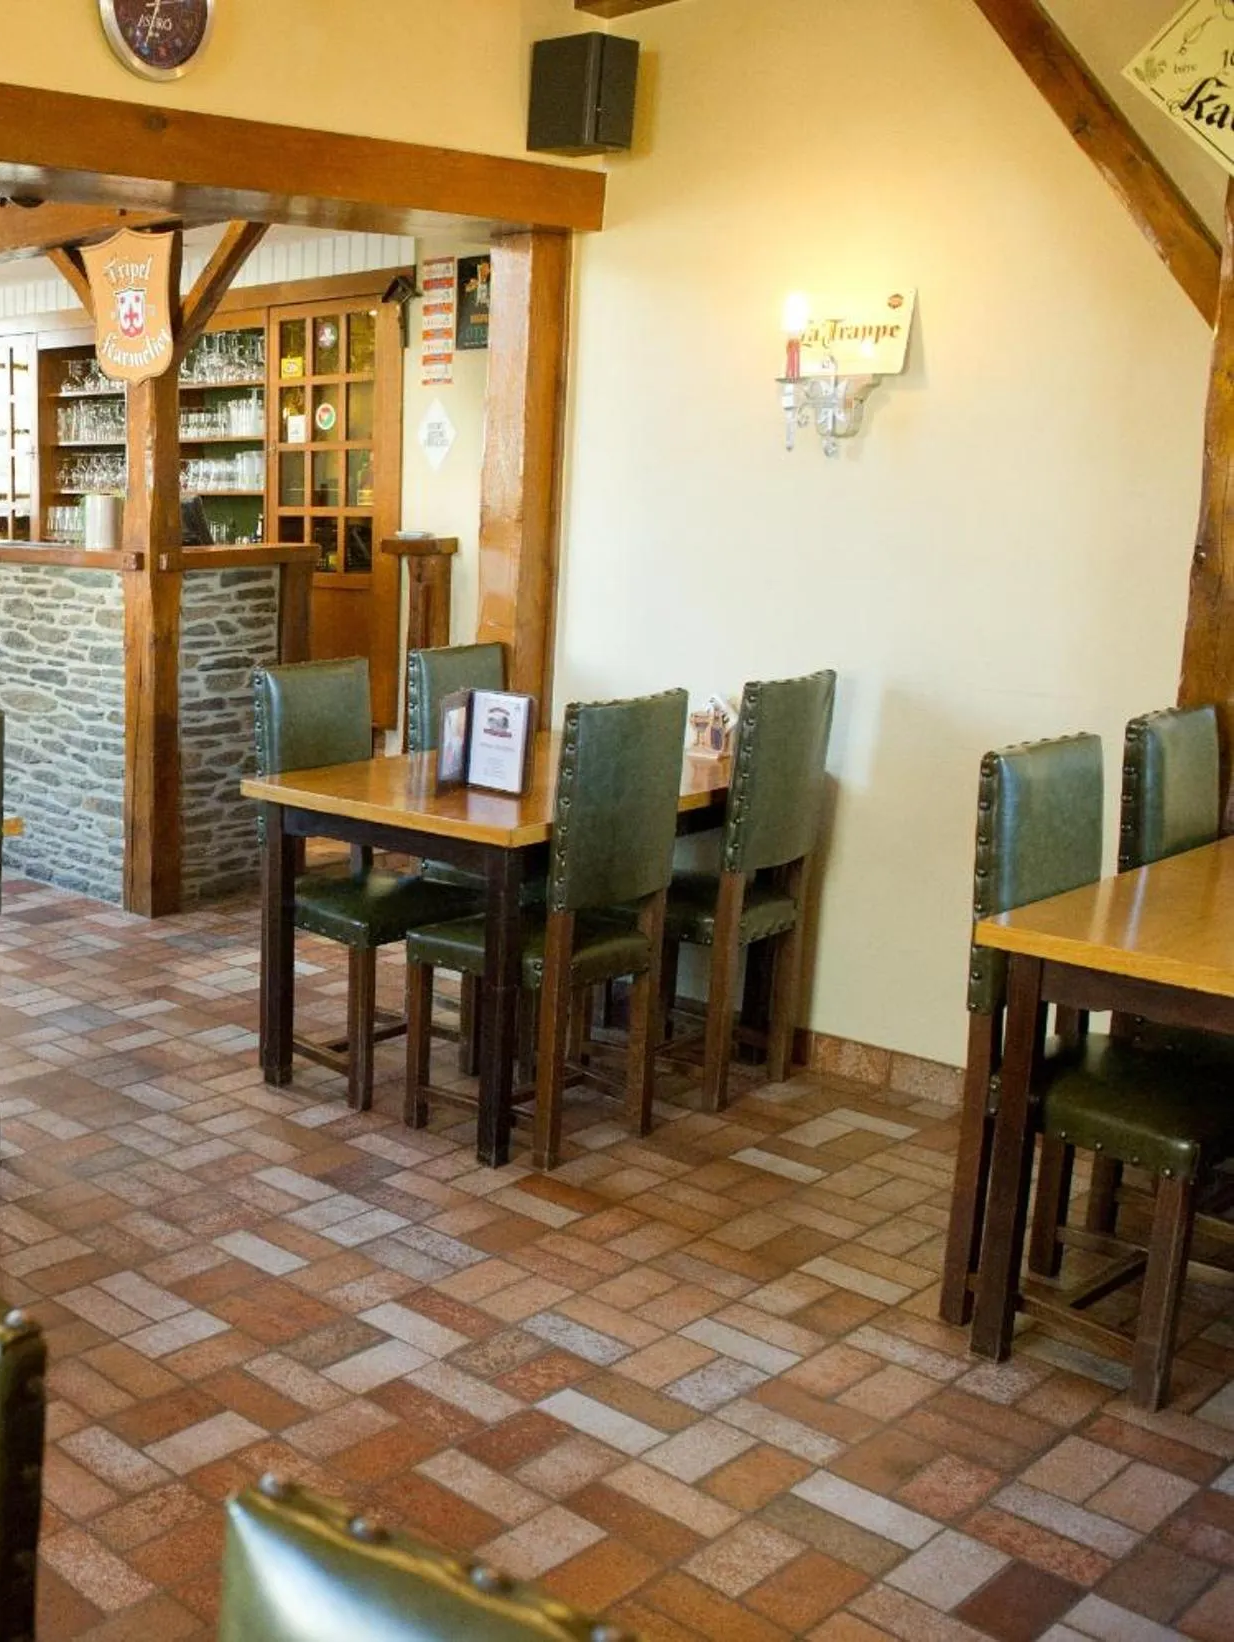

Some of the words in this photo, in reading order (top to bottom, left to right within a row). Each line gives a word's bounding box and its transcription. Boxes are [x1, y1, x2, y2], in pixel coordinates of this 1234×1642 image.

[1177, 76, 1234, 131] Ka
[103, 254, 153, 286] Tripel
[822, 318, 901, 348] Trappe
